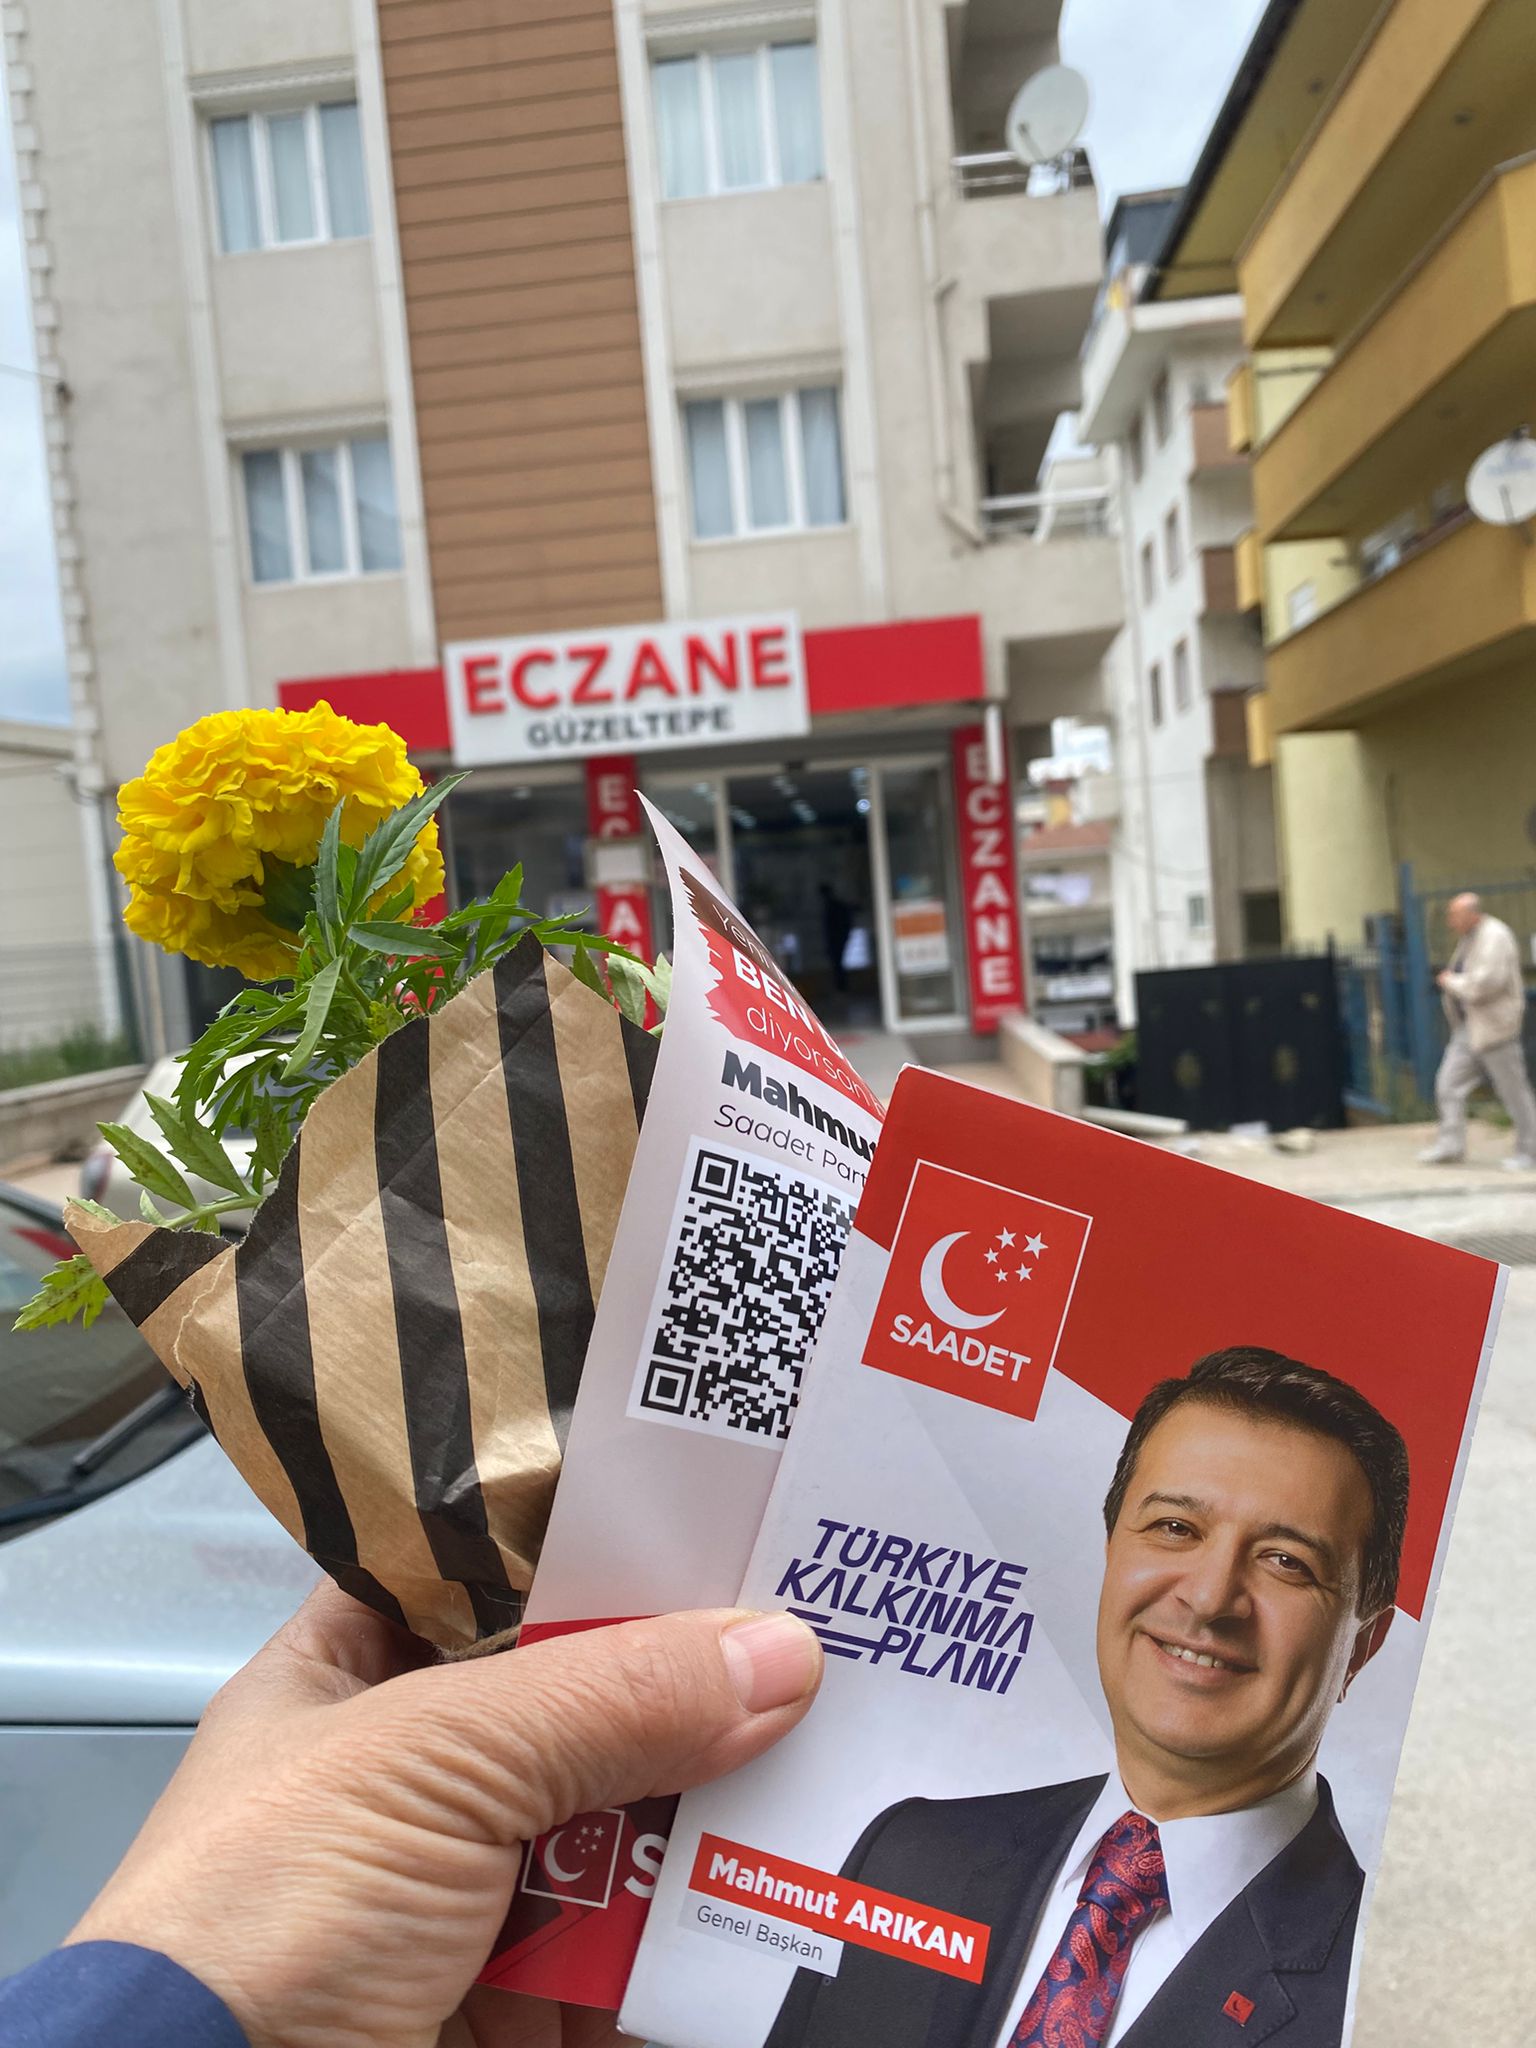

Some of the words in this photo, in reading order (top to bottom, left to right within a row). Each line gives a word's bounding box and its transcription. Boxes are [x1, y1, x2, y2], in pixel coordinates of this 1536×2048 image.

[461, 627, 791, 716] ECZANE
[527, 705, 734, 748] GÜZELTEPE
[967, 742, 1014, 997] ECZANE
[732, 947, 814, 1034] BEN
[714, 1104, 816, 1162] Saadet
[889, 1313, 1032, 1384] SAADET
[811, 1517, 1029, 1606] TÜRKİYE
[775, 1558, 1036, 1655] KALKINMA
[871, 1626, 1023, 1695] PLANI
[696, 1904, 751, 1938] Genel
[756, 1924, 824, 1961] Başkan
[708, 1852, 840, 1922] Mahmut
[843, 1904, 976, 1965] ARIKAN
